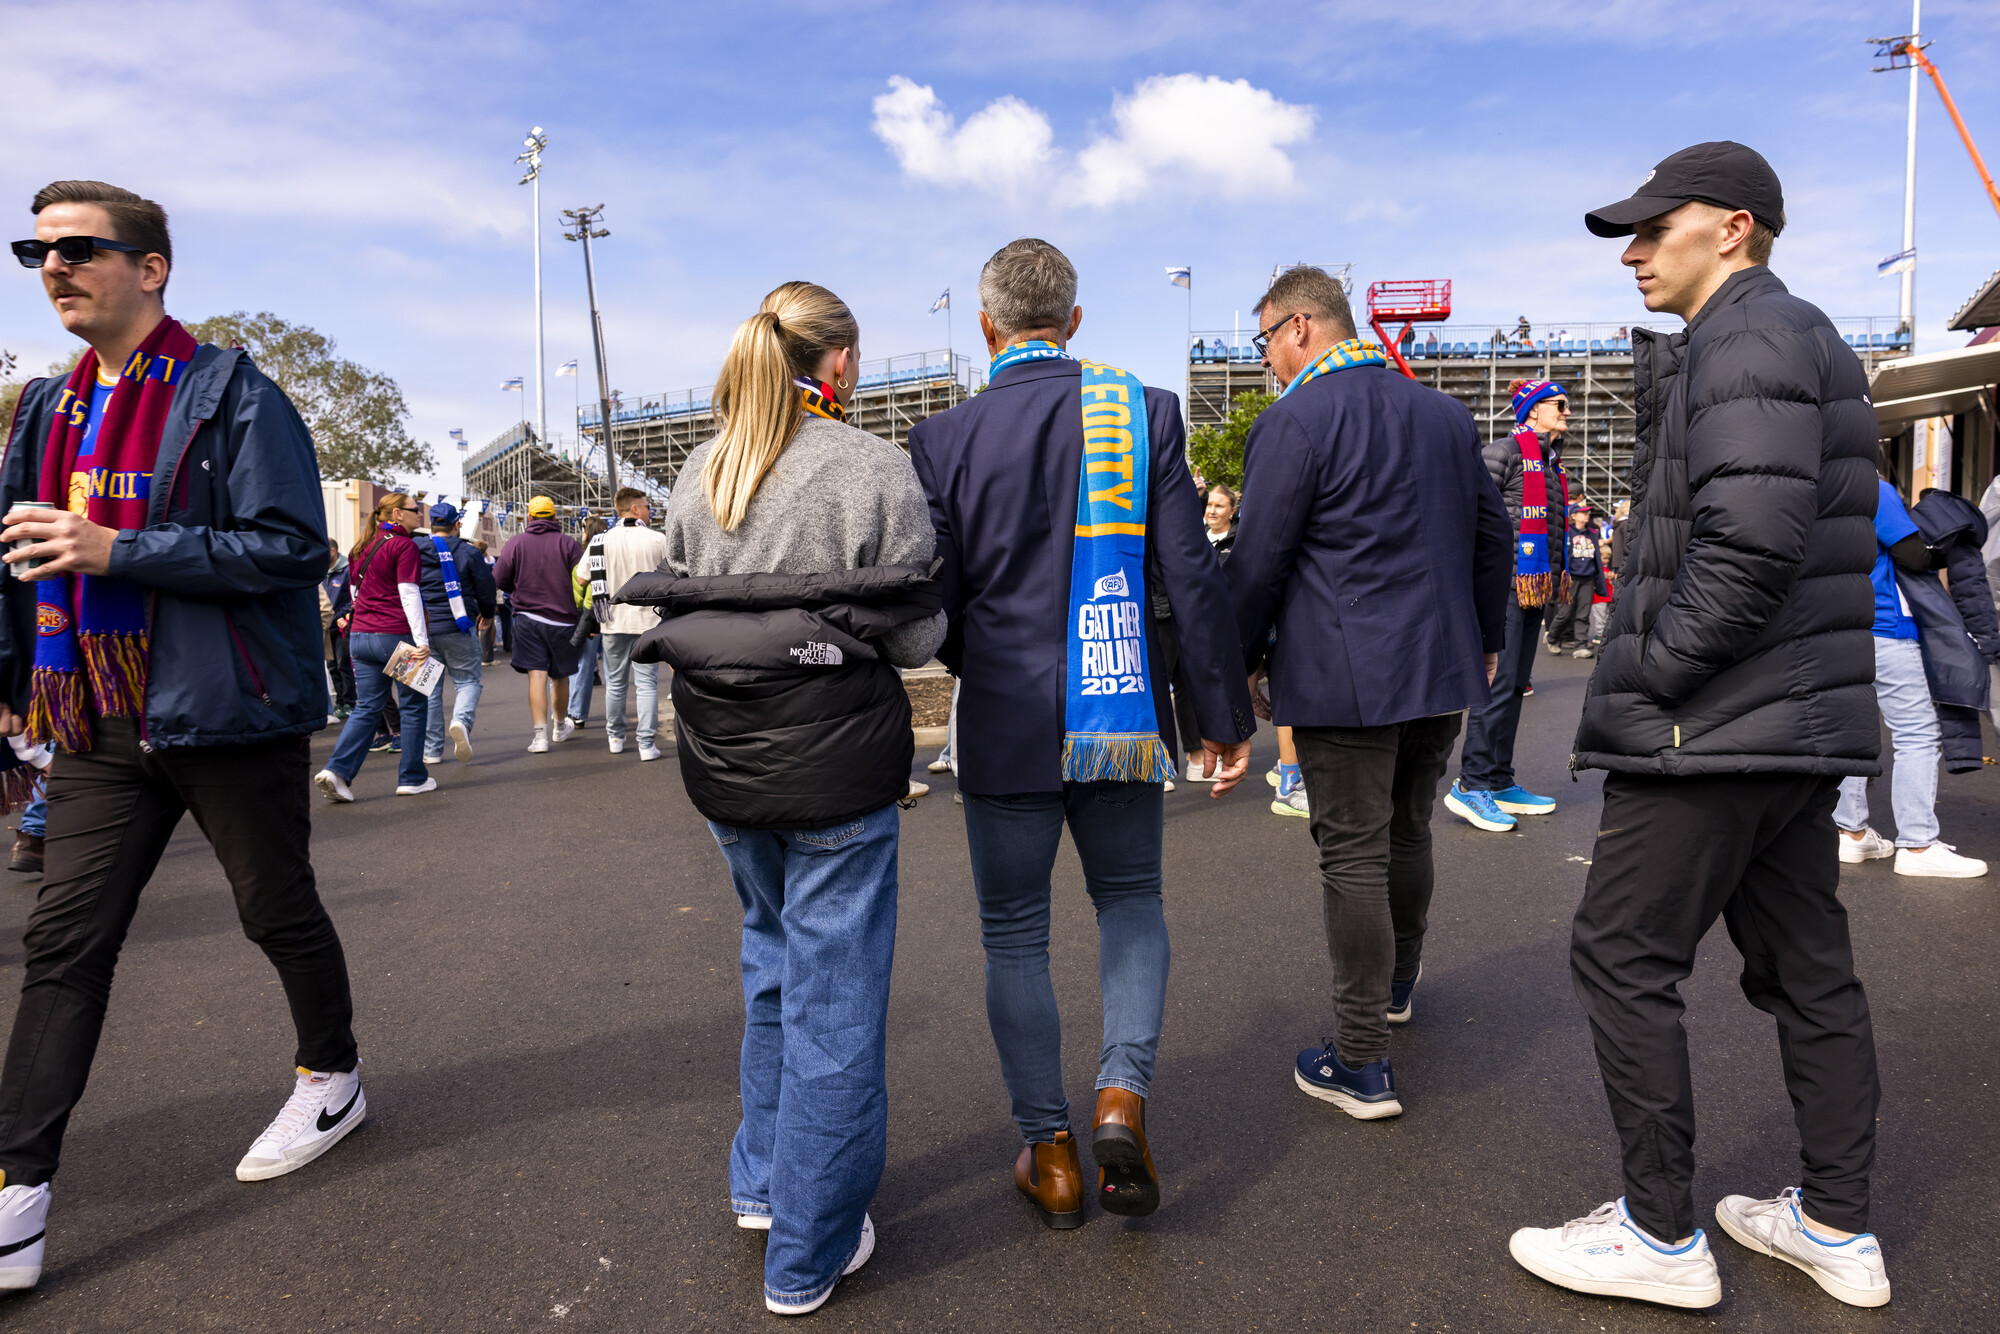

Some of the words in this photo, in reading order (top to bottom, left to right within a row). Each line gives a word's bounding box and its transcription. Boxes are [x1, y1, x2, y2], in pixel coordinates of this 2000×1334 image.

[1081, 384, 1133, 511] FOOTY
[1106, 581, 1121, 589] AFL
[1079, 602, 1141, 640] GATHER
[790, 648, 826, 659] NORTH
[806, 641, 826, 651] THE
[800, 657, 825, 665] FACE
[1082, 639, 1142, 677] ROUND
[1081, 675, 1145, 695] 2026
[1466, 799, 1485, 815] HOKA
